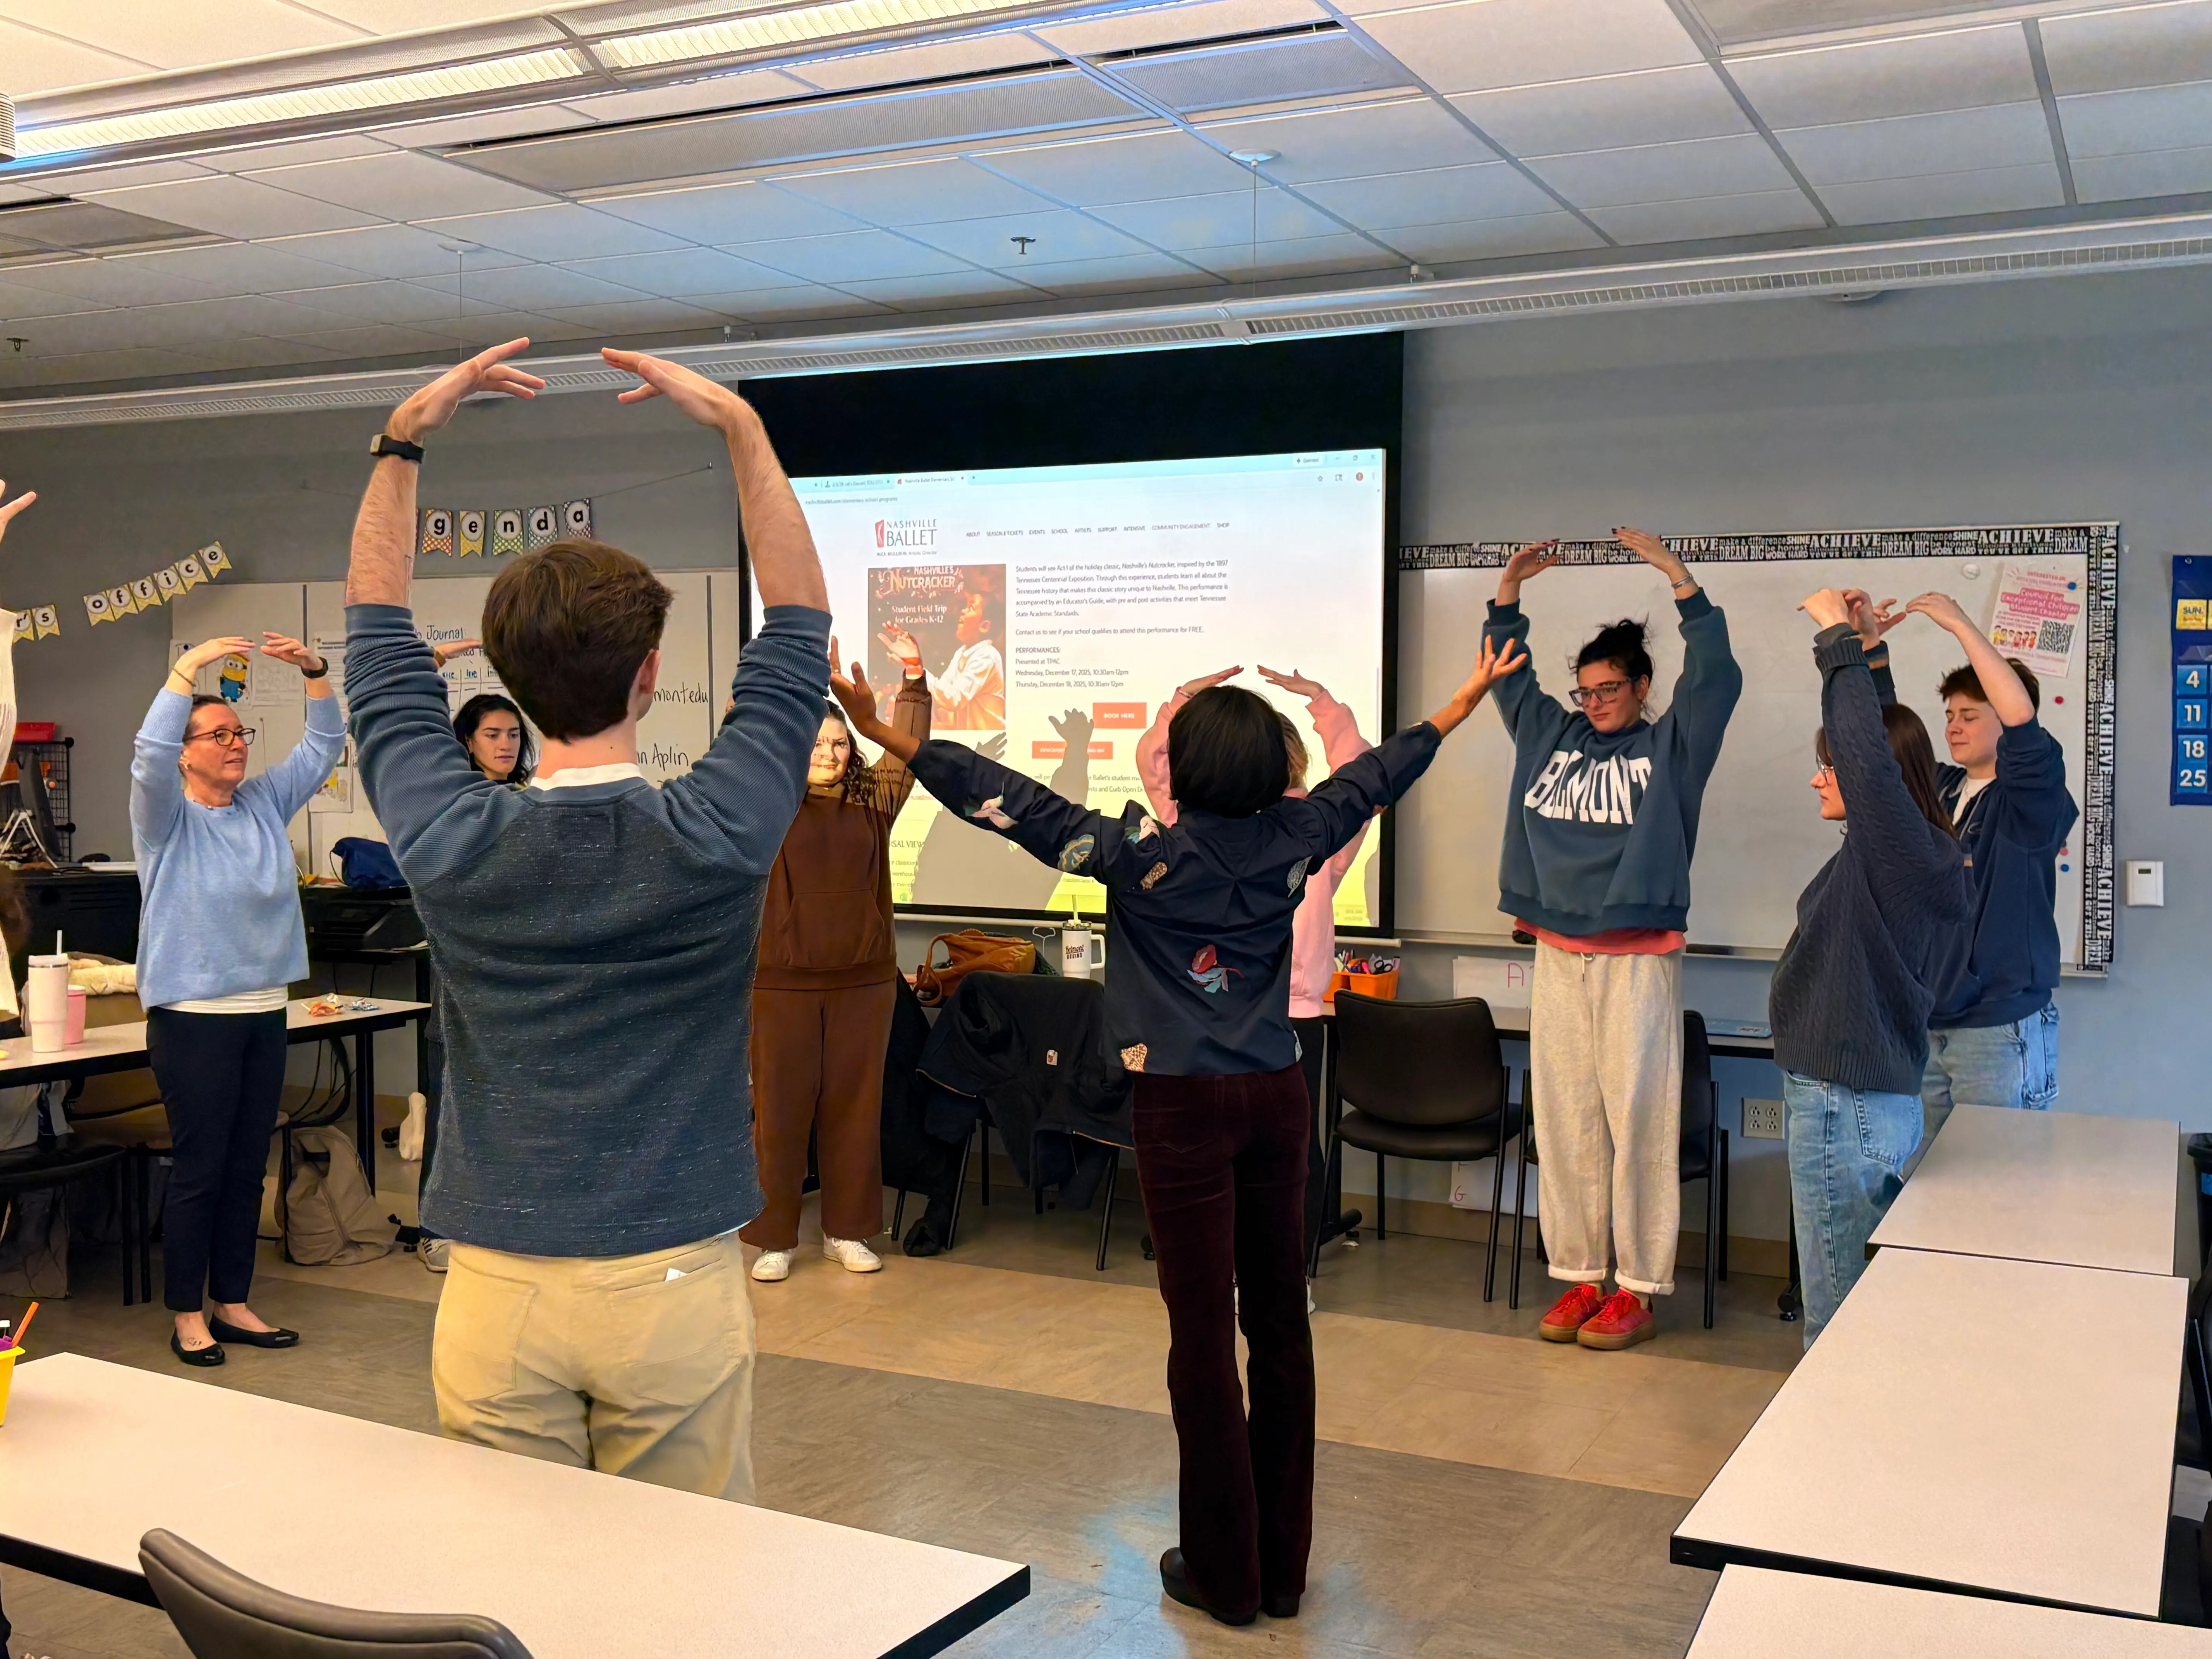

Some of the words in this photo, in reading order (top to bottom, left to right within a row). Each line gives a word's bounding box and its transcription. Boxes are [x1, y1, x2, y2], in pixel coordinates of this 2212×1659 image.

[433, 508, 584, 536] genda
[886, 519, 937, 529] NASHVILLE
[886, 529, 937, 547] BALLET
[1786, 535, 1811, 545] SHINE
[1810, 533, 1881, 548] ACHIEVE
[1882, 532, 1903, 541] make
[1911, 531, 1953, 541] difference
[1953, 531, 1978, 541] SHINE
[1978, 528, 2054, 543] ACHIEVE
[1480, 544, 1502, 553] SHINE
[1719, 545, 1748, 561] DREAM
[1750, 544, 1764, 560] BIG
[1882, 541, 1912, 556] DREAM
[1914, 541, 1929, 556] BIG
[1930, 547, 1953, 555] WORK
[1954, 546, 1976, 555] HARD
[2054, 536, 2088, 553] DREAM
[1430, 553, 1456, 568] DREAM
[1457, 552, 1469, 567] BIG
[1565, 549, 1592, 564] DREAM
[1594, 548, 1607, 563] BIG
[1765, 551, 1787, 560] WORK
[1788, 550, 1808, 559] HARD
[92, 548, 218, 609] office
[890, 568, 956, 592] NUTCRACKER
[2101, 536, 2117, 609] ACHIEVE
[2021, 589, 2049, 599] Council
[892, 605, 916, 613] Student
[934, 605, 947, 613] Trip
[2002, 594, 2045, 608] Exceptional
[2048, 602, 2079, 613] Children
[2040, 608, 2067, 618] Chapter
[427, 625, 464, 641] Journal
[2186, 671, 2200, 688] 4
[2184, 704, 2201, 722] 11
[2099, 703, 2114, 775] ACHIEVE
[652, 743, 689, 771] Aplin
[2183, 740, 2205, 758] 18
[2179, 769, 2206, 787] 25
[2097, 867, 2112, 939] ACHIEVE
